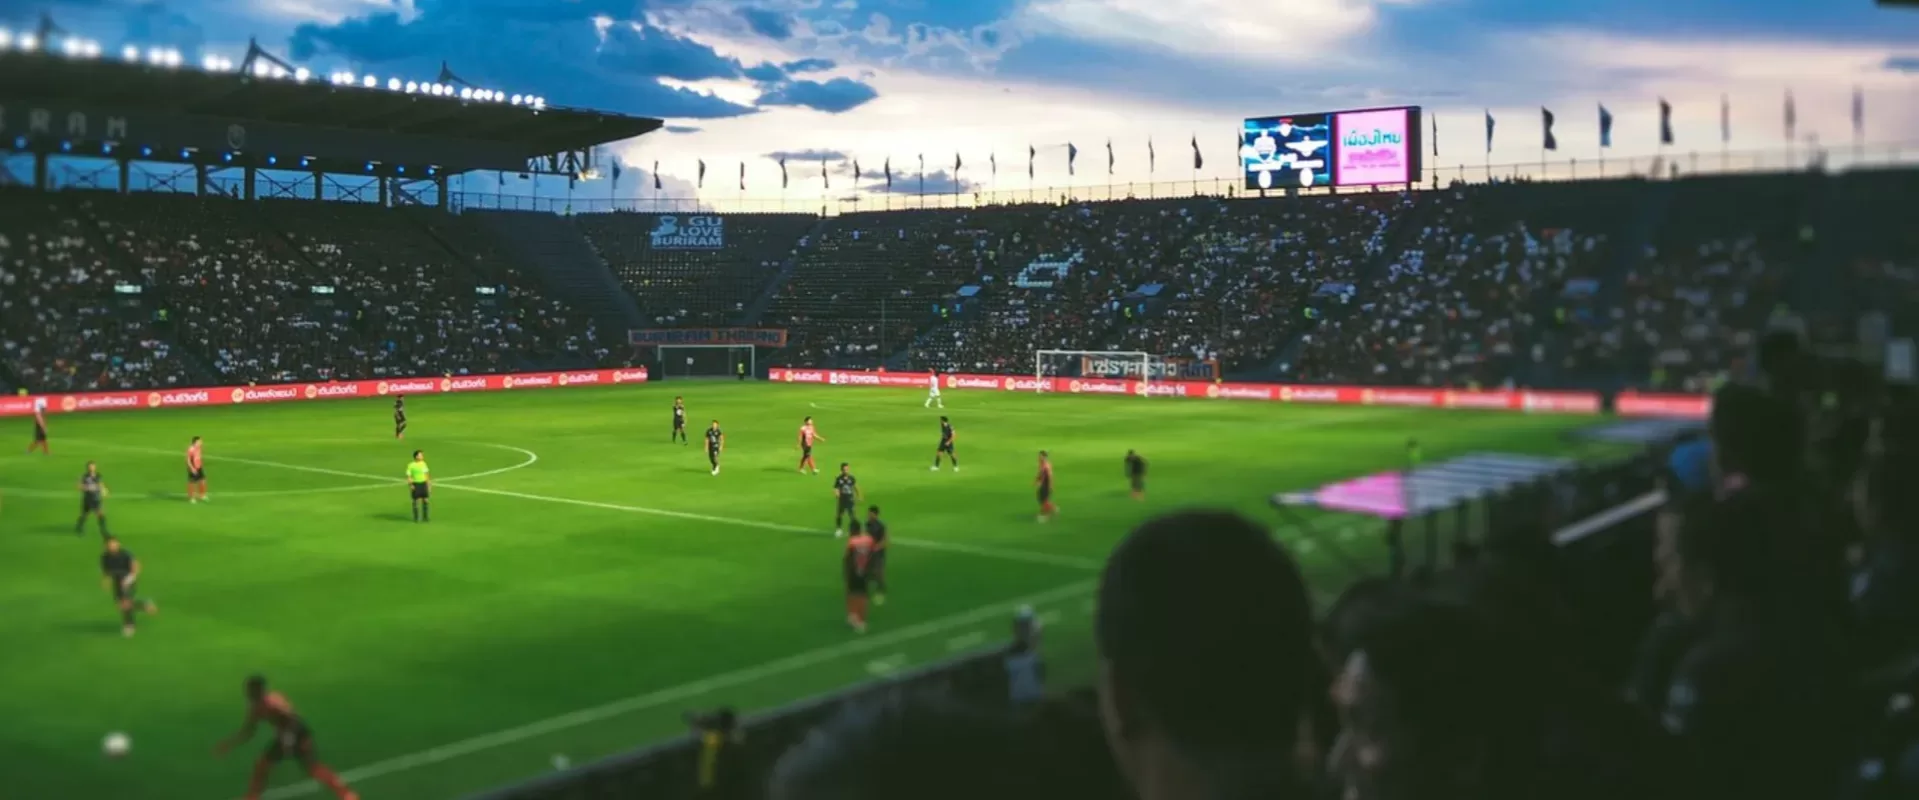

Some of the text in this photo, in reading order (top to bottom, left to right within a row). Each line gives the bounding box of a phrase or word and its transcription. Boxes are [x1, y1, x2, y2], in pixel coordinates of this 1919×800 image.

[689, 216, 723, 226] GU
[680, 227, 723, 236] LOVE
[652, 236, 722, 246] BURIRAM
